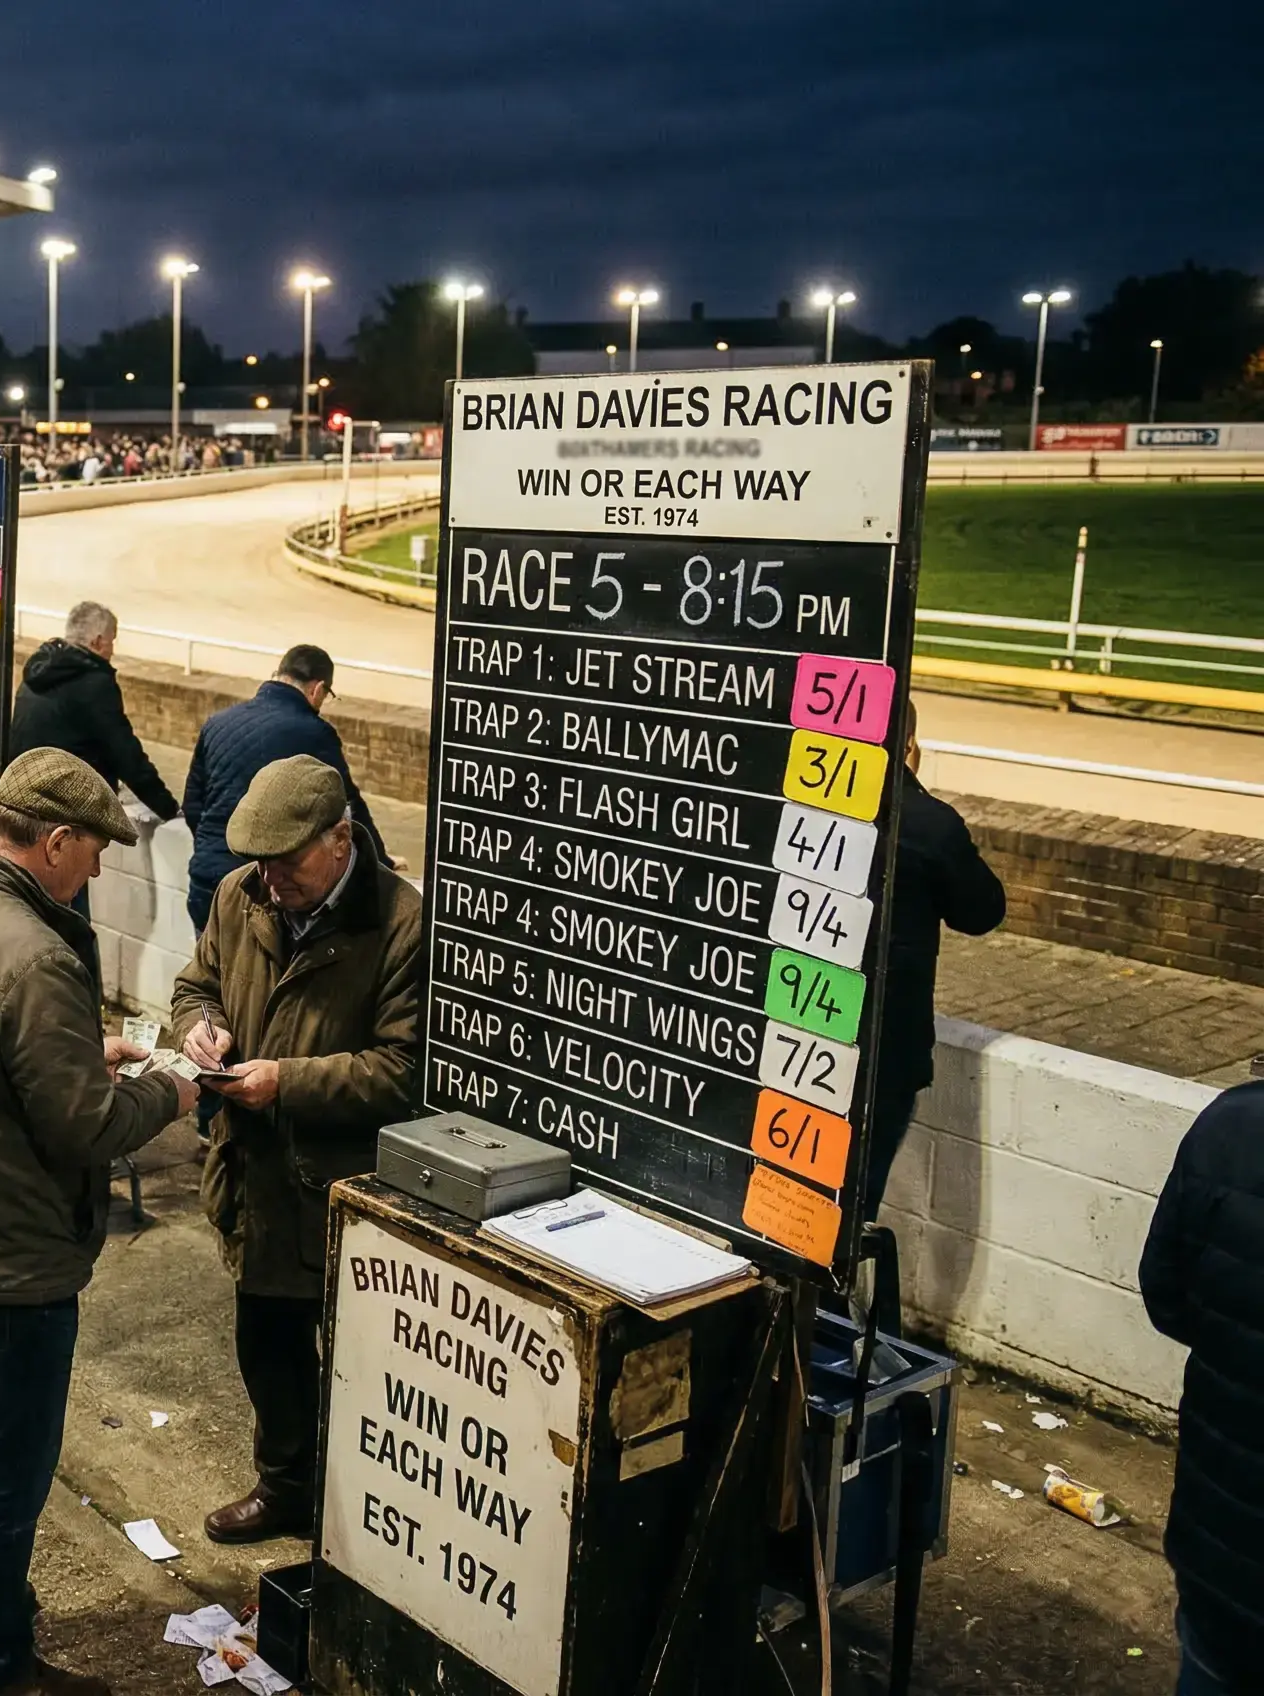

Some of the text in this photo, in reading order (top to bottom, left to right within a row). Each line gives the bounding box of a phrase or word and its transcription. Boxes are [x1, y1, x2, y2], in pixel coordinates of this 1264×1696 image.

[462, 379, 893, 431] BRIAN DAVIES RACING
[518, 469, 810, 501] WIN OR EACH WAY
[604, 508, 698, 528] EST. 1974
[462, 548, 850, 637] RACE 5 - 8:15 PM
[453, 636, 774, 709] TRAP 1: JET STREAM
[806, 671, 866, 724] 5/1
[450, 698, 738, 776] TRAP 2: BALLYMAC
[799, 746, 857, 798] 3/1
[447, 758, 750, 849] TRAP 3: FLASH GIRL
[788, 816, 846, 871] 4/1
[444, 818, 762, 924] TRAP 4: SMOKEY JOE
[440, 878, 756, 994] TRAP 4: SMOKEY JOE
[788, 889, 848, 948] 9/4
[438, 937, 758, 1067] TRAP 5: NIGHT WINGS
[780, 963, 842, 1023] 9/4
[435, 996, 706, 1118] TRAP 6: VELOCITY
[776, 1033, 836, 1095] 7/2
[432, 1058, 620, 1160] TRAP 7: CASH
[768, 1107, 820, 1164] 6/1
[350, 1256, 565, 1387] BRIAN DAVIES
[393, 1308, 508, 1399] RACING
[384, 1372, 508, 1476] WIN OR
[359, 1416, 532, 1546] EACH WAY
[363, 1492, 517, 1622] EST. 1974
